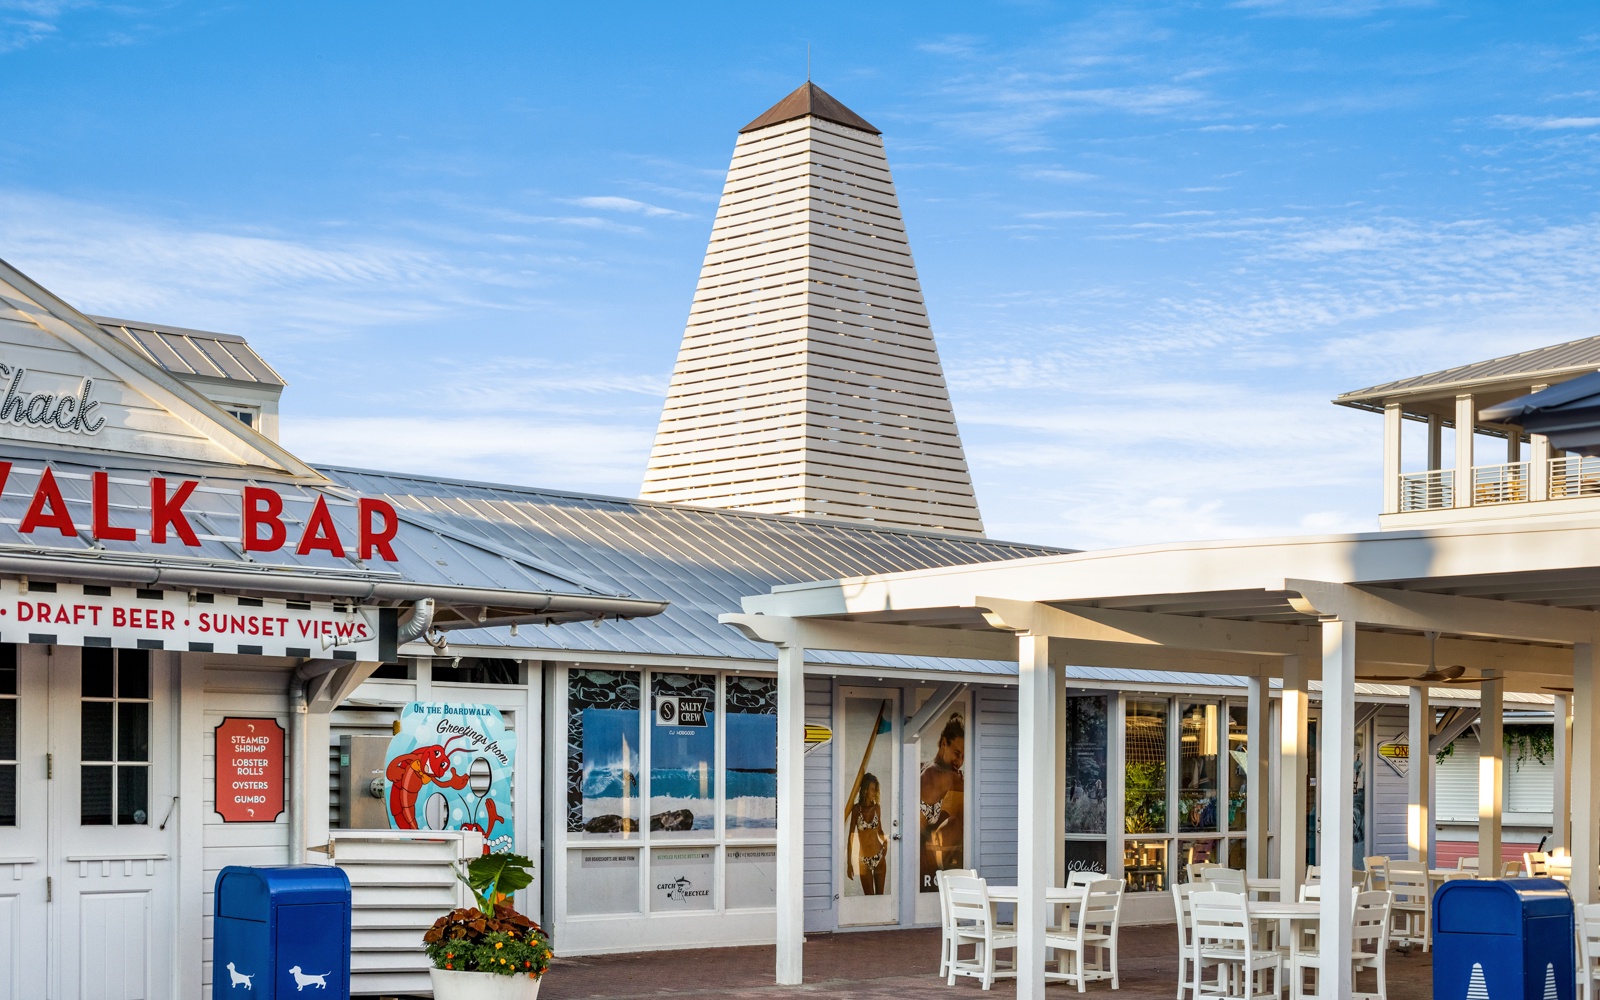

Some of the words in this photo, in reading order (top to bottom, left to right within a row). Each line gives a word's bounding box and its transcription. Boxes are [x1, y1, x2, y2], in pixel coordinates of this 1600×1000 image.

[0, 363, 105, 431] hack
[242, 486, 399, 562] BAR
[17, 601, 102, 625] DRAFT
[113, 607, 175, 630] BEER
[198, 612, 289, 636] SUNSET
[297, 619, 367, 639] VIEWS
[680, 702, 702, 711] SALTY
[681, 712, 701, 721] CREW
[231, 736, 269, 744] STEAMED
[436, 718, 486, 745] Greetings
[484, 740, 508, 764] from
[235, 745, 266, 753] SHRIMP
[232, 758, 268, 766] LOBSTER
[237, 767, 263, 775] ROLLS
[232, 781, 268, 789] OYSTERS
[234, 795, 266, 803] GUMBO
